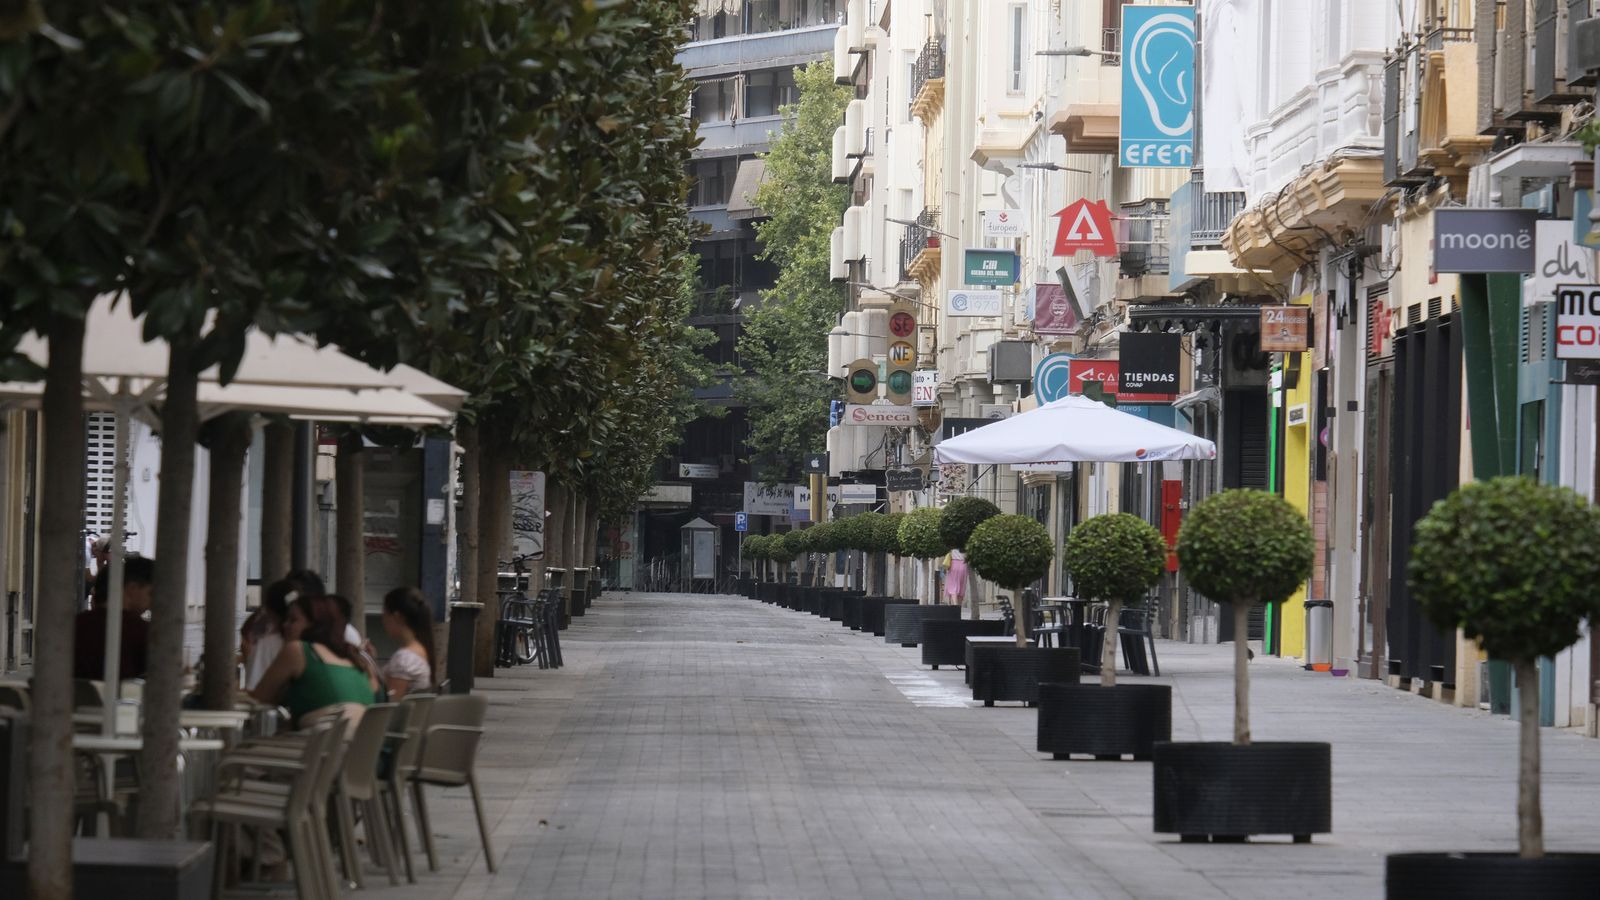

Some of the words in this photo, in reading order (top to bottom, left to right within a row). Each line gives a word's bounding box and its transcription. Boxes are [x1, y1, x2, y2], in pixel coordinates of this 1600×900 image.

[1440, 229, 1531, 249] moonë
[1543, 240, 1586, 278] dh
[1266, 310, 1284, 324] 24
[1557, 325, 1600, 345] co
[893, 346, 910, 361] NE
[1097, 372, 1119, 382] CA
[1124, 372, 1175, 382] TIENDAS
[853, 407, 911, 422] Seneca
[737, 515, 746, 525] P
